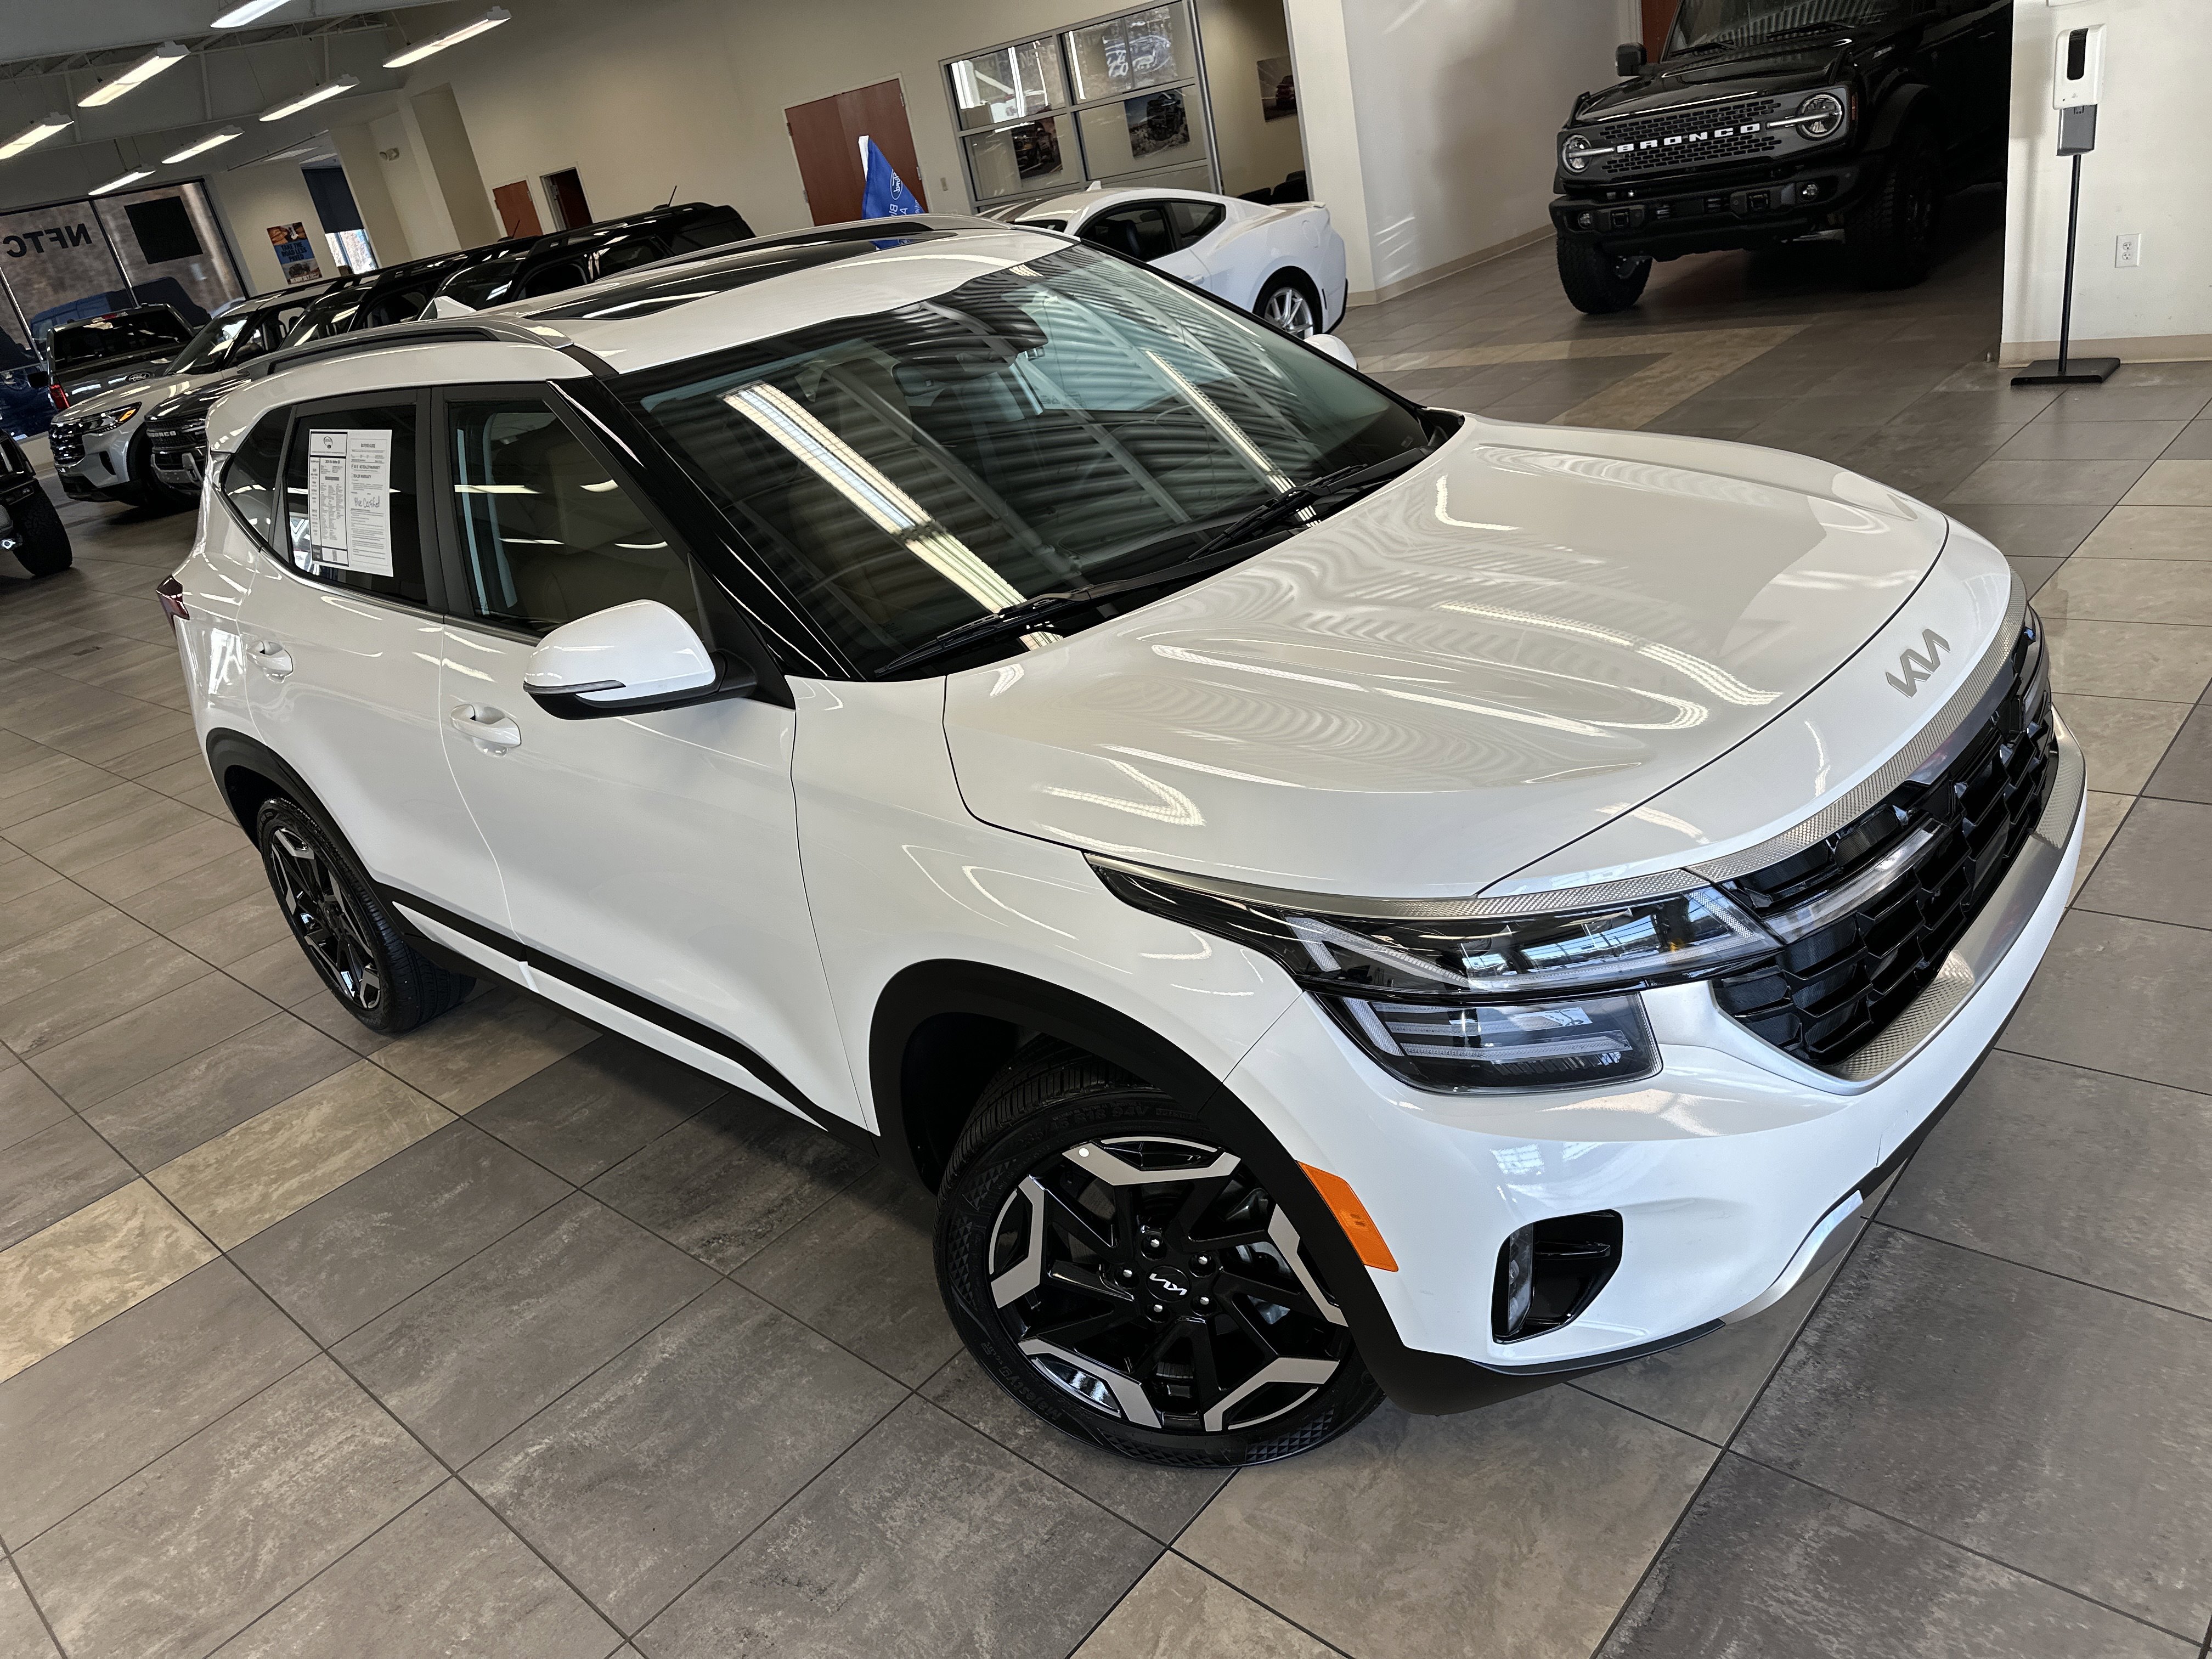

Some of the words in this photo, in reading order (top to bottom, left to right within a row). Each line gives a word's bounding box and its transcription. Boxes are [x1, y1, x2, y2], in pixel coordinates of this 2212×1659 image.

[1617, 123, 1760, 154] BRONCO
[281, 243, 293, 252] TAKE
[281, 249, 295, 257] ROAD
[1885, 629, 1951, 699] KIA
